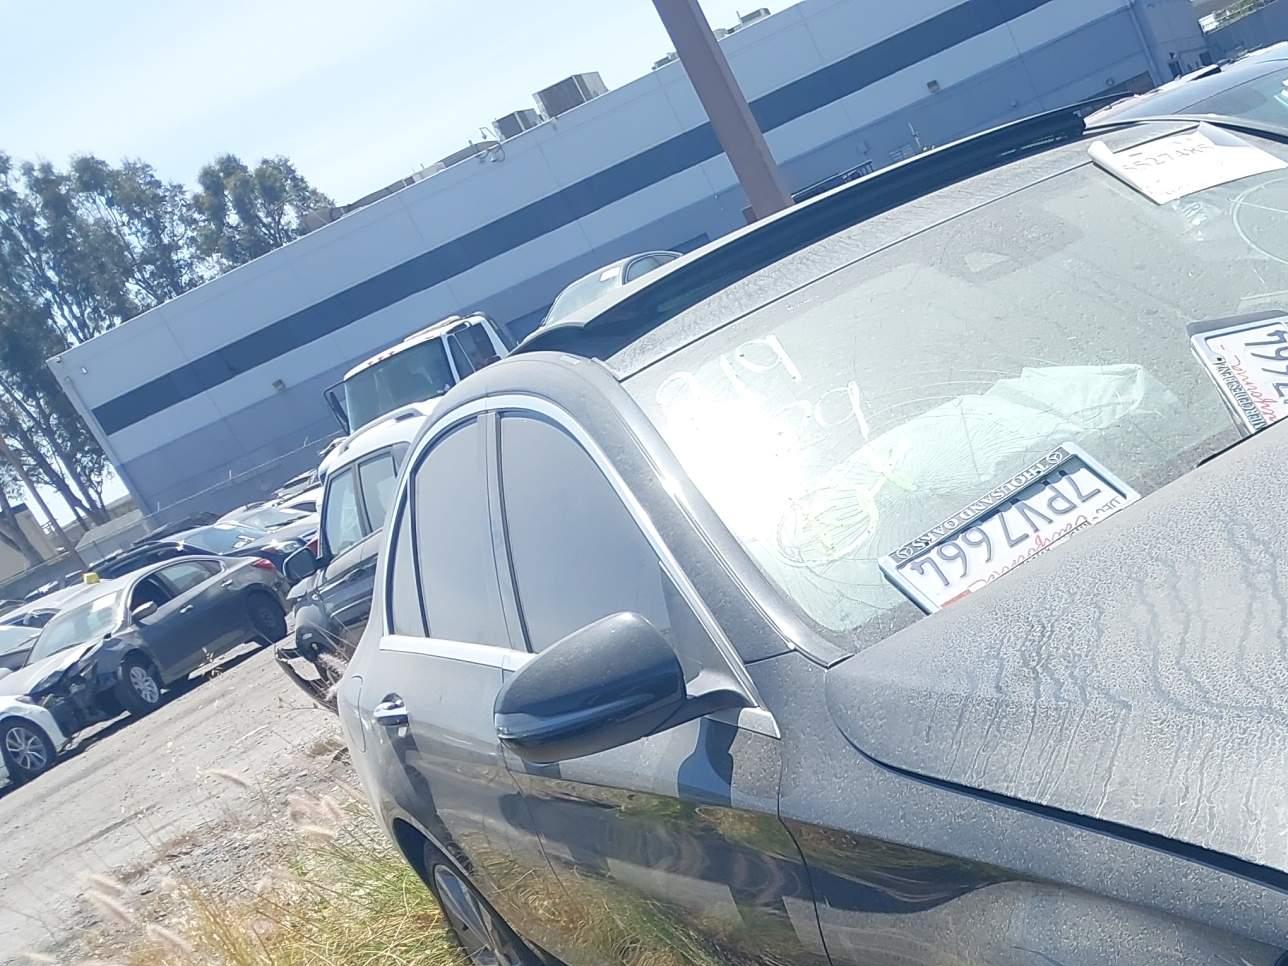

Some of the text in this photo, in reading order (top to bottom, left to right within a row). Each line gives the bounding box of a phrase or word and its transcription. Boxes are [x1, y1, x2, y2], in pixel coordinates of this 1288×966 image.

[1230, 355, 1278, 422] alifornia
[909, 470, 1102, 588] 7PV7664
[911, 460, 1052, 551] THOUSAND OAKS
